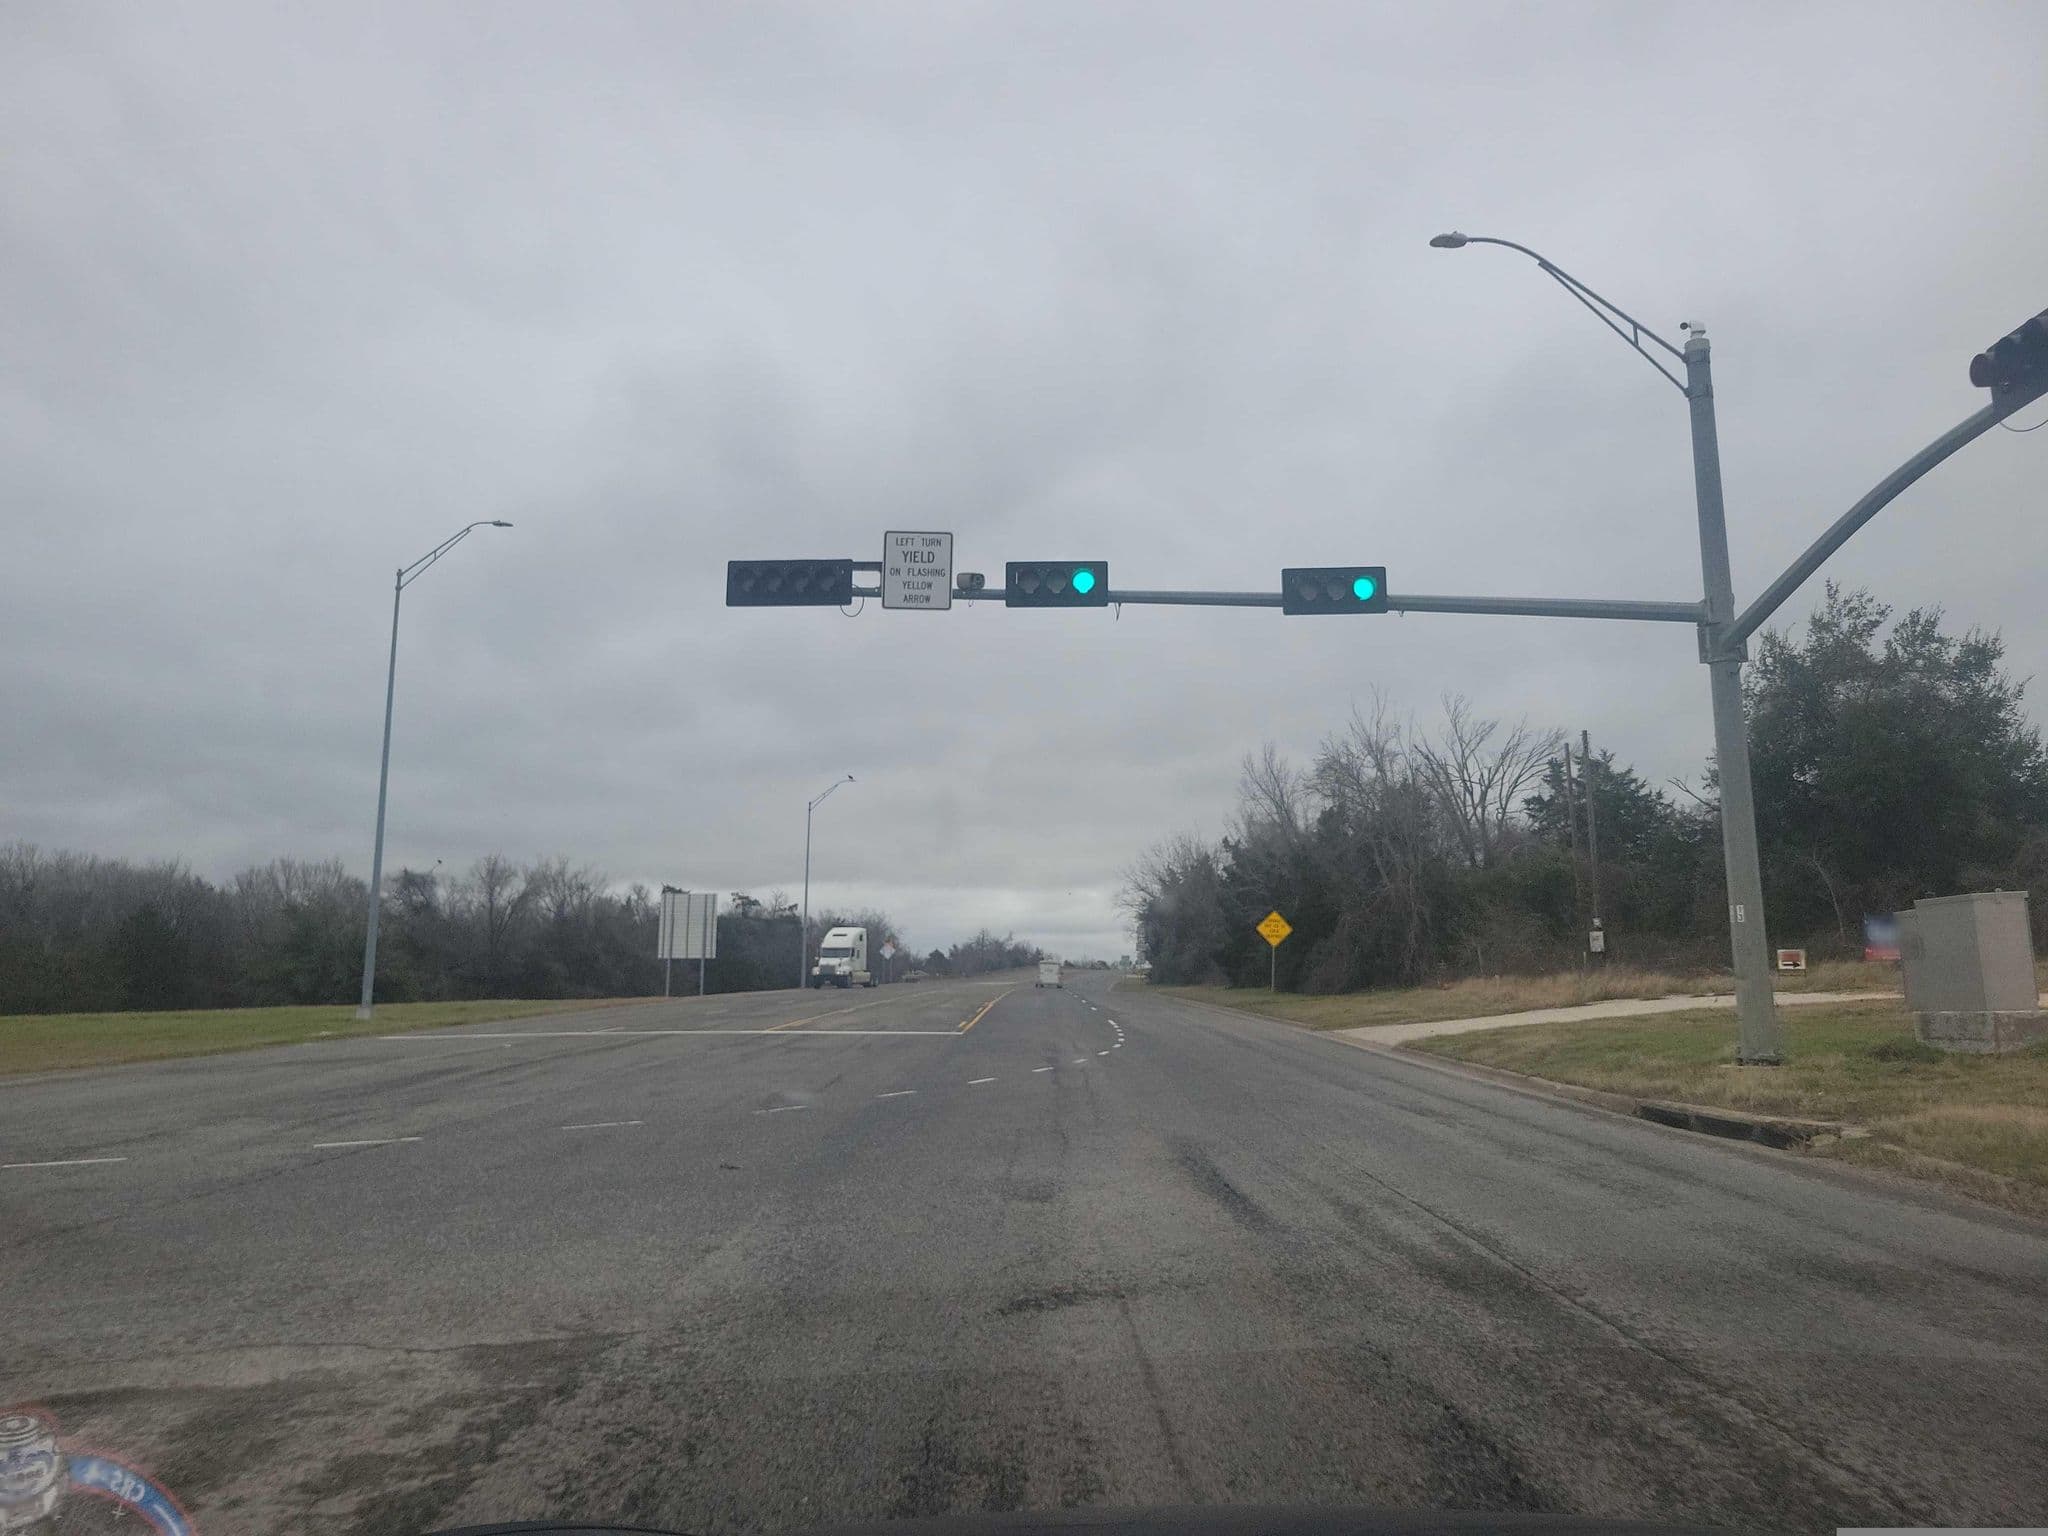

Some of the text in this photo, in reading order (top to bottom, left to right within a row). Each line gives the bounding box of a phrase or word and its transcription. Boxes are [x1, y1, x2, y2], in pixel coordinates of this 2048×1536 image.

[896, 537, 942, 547] LEFT TURN
[902, 551, 935, 563] YIELD
[889, 567, 946, 577] ON FLASHING
[902, 581, 933, 590] YELLOW
[903, 594, 931, 603] ARROW
